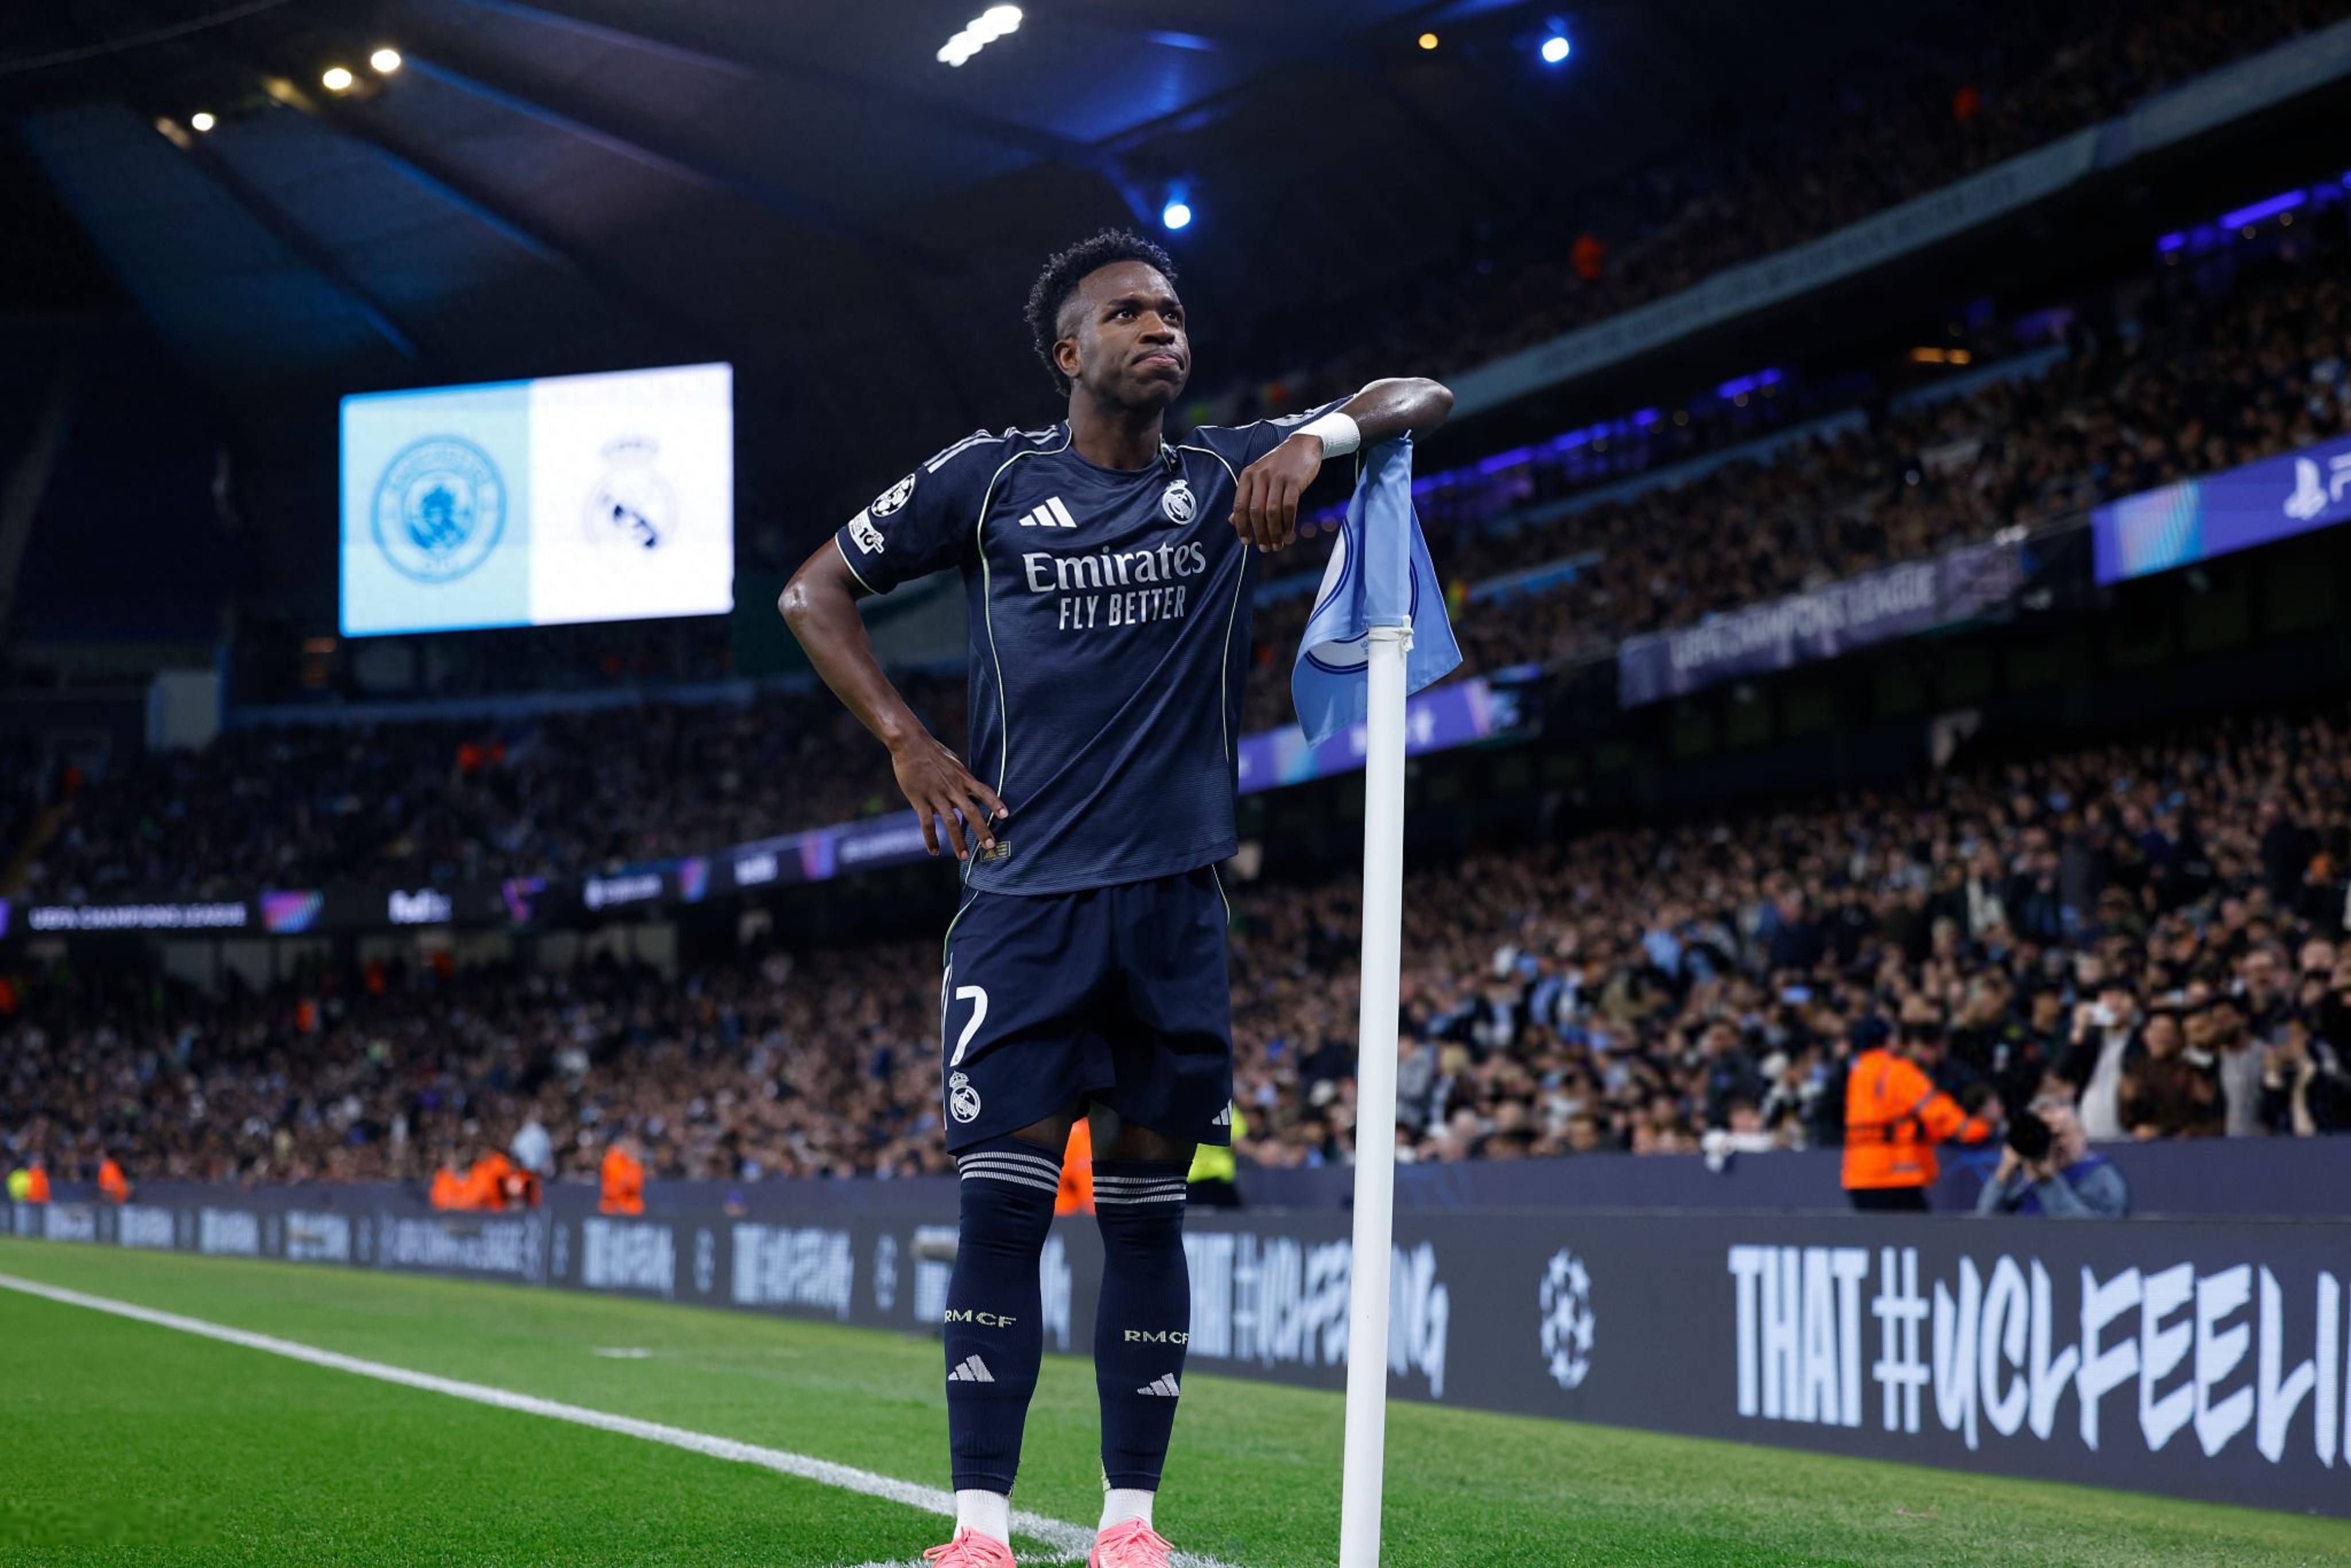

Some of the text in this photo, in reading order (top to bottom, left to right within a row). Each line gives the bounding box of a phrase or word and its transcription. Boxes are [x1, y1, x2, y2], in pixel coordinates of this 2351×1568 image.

[1022, 541, 1206, 593] Emirates
[1059, 585, 1186, 630] FLY BETTER
[950, 985, 988, 1067] 7
[944, 1309, 1017, 1328] RMCF
[1872, 1247, 2351, 1468] #UCLFEELI
